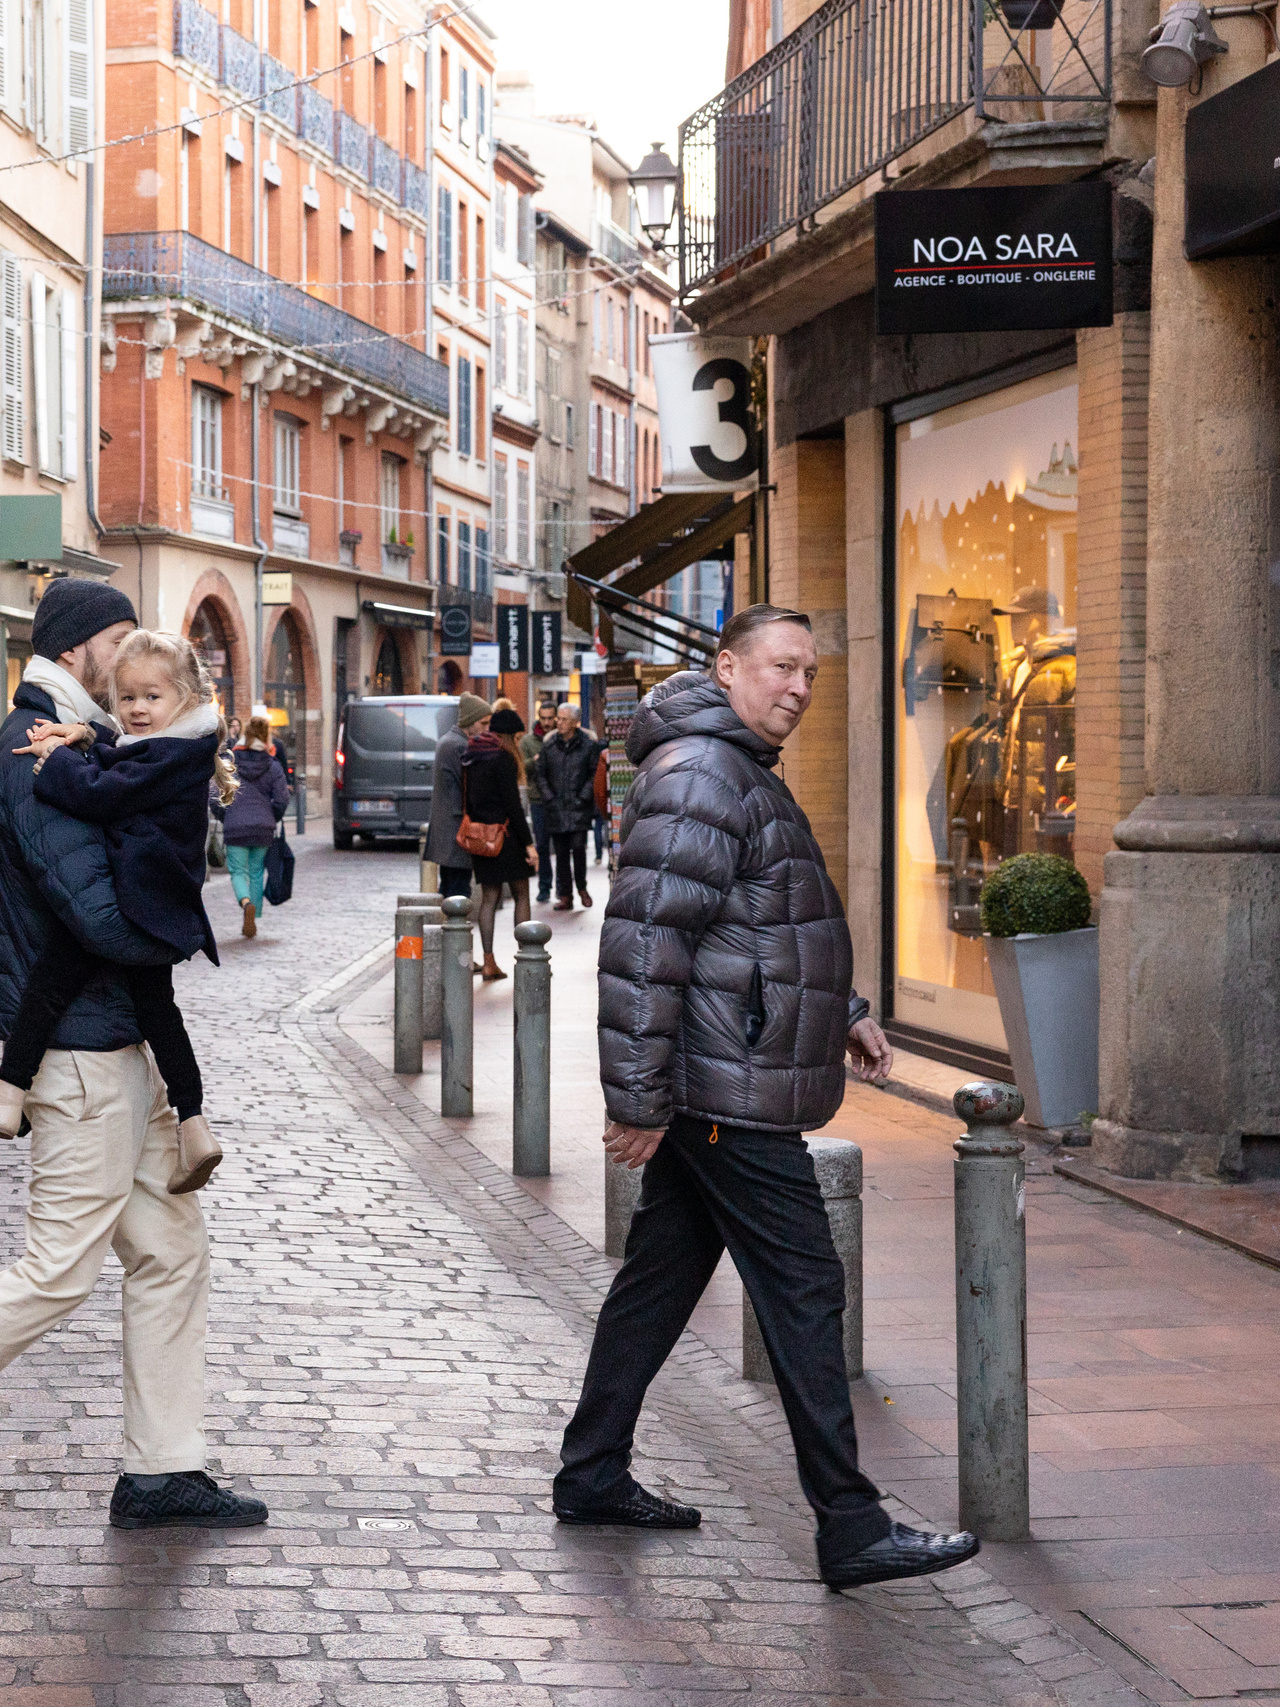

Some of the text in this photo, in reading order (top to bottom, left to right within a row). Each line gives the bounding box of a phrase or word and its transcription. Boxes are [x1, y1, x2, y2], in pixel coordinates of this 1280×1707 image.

[913, 232, 1078, 263] NOA SARA
[893, 274, 946, 287] AGENCE
[956, 272, 1022, 285] BOUTIQUE
[1033, 269, 1096, 282] ONGLERIE
[689, 358, 759, 482] 3
[508, 608, 519, 670] carhartt
[542, 614, 553, 673] carhartt
